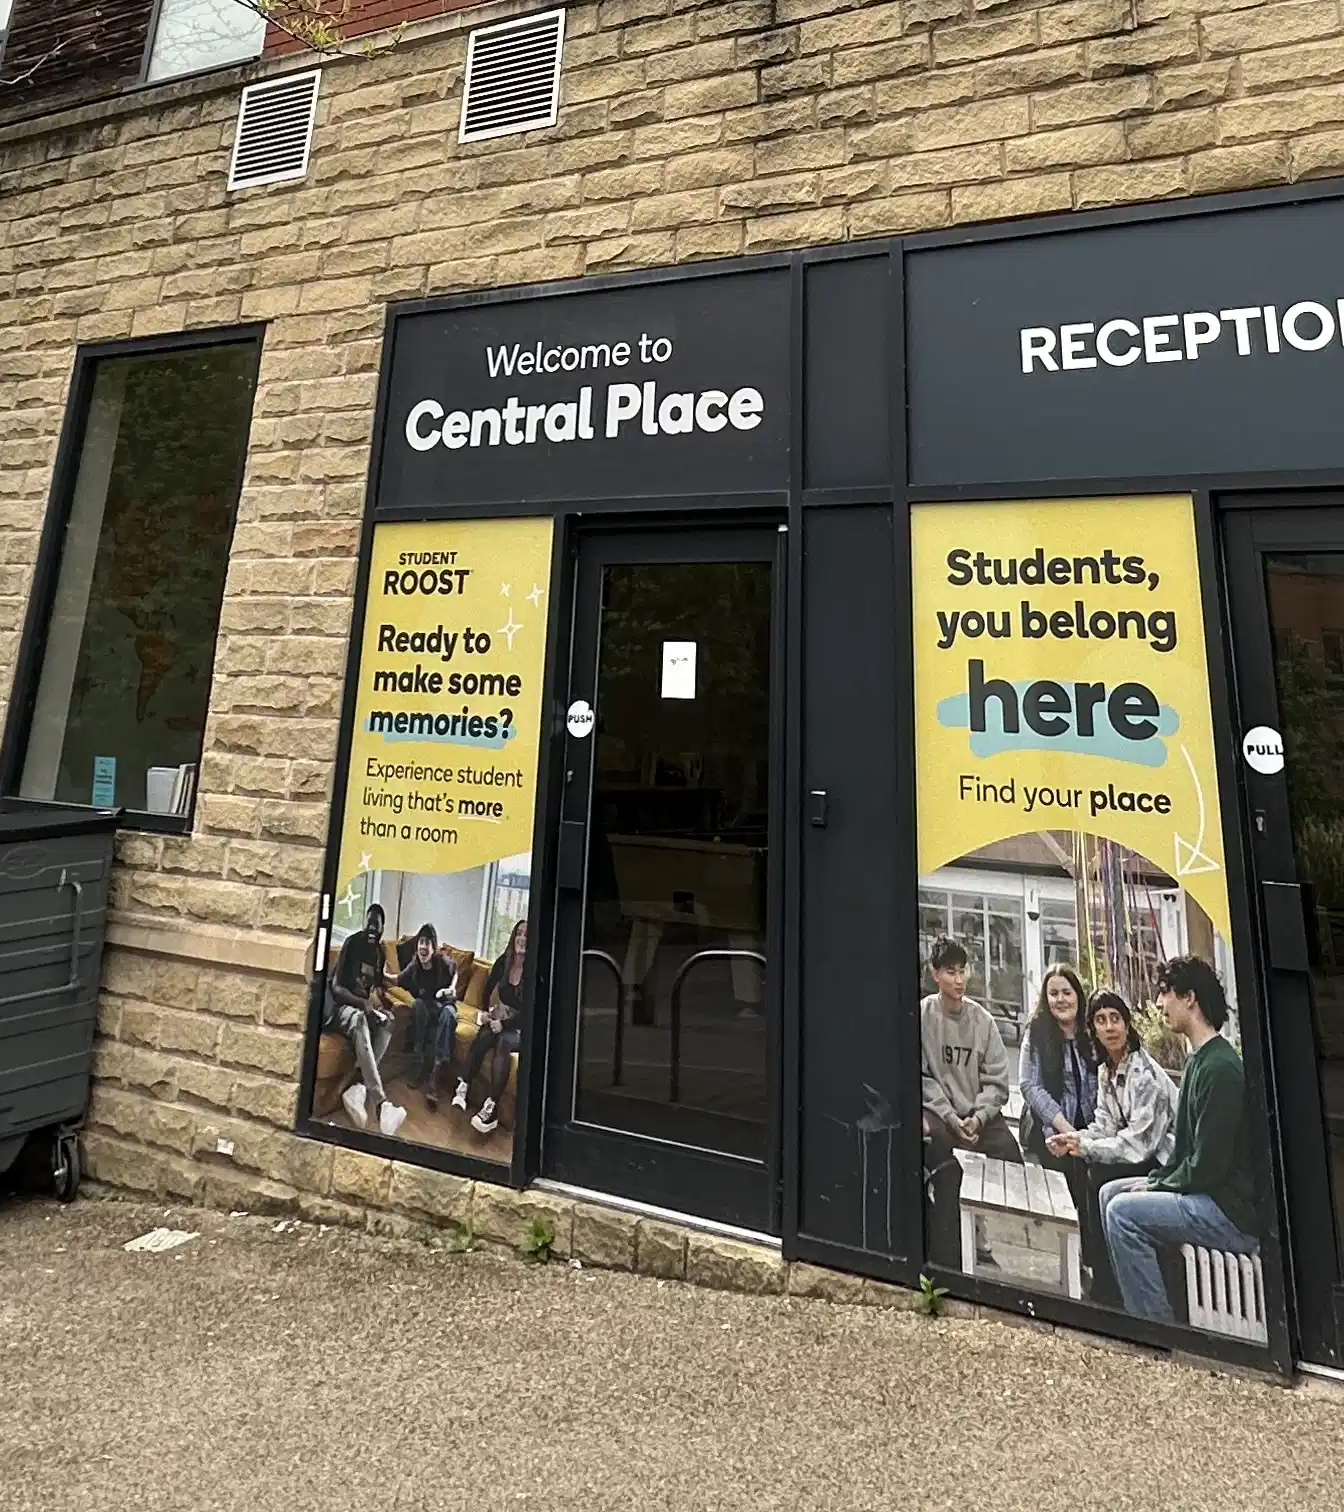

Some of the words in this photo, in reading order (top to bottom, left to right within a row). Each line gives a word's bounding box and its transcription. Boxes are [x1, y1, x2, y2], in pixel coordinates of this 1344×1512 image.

[486, 341, 631, 378] Welcome
[638, 333, 673, 364] to
[405, 385, 595, 452] Central
[605, 381, 764, 438] Place
[398, 551, 458, 565] STUDENT
[946, 548, 1159, 592] Students,
[383, 569, 471, 596] ROOST
[378, 624, 459, 662] Ready
[463, 627, 491, 654] to
[936, 610, 1011, 649] you
[1021, 600, 1177, 653] belong
[373, 664, 443, 694] make
[448, 672, 522, 697] some
[968, 658, 1160, 741] here
[369, 706, 514, 739] memories?
[567, 714, 593, 724] PUSH
[1247, 744, 1284, 756] PULL
[366, 757, 453, 783] Experience
[457, 766, 523, 788] student
[362, 787, 404, 814] living
[407, 790, 454, 813] that's
[458, 799, 503, 817] more
[959, 774, 1015, 804] Find
[1023, 785, 1083, 812] your
[1090, 784, 1172, 817] place
[359, 816, 396, 839] than
[401, 825, 410, 840] a
[415, 826, 458, 844] room
[942, 1045, 973, 1067] 1977
